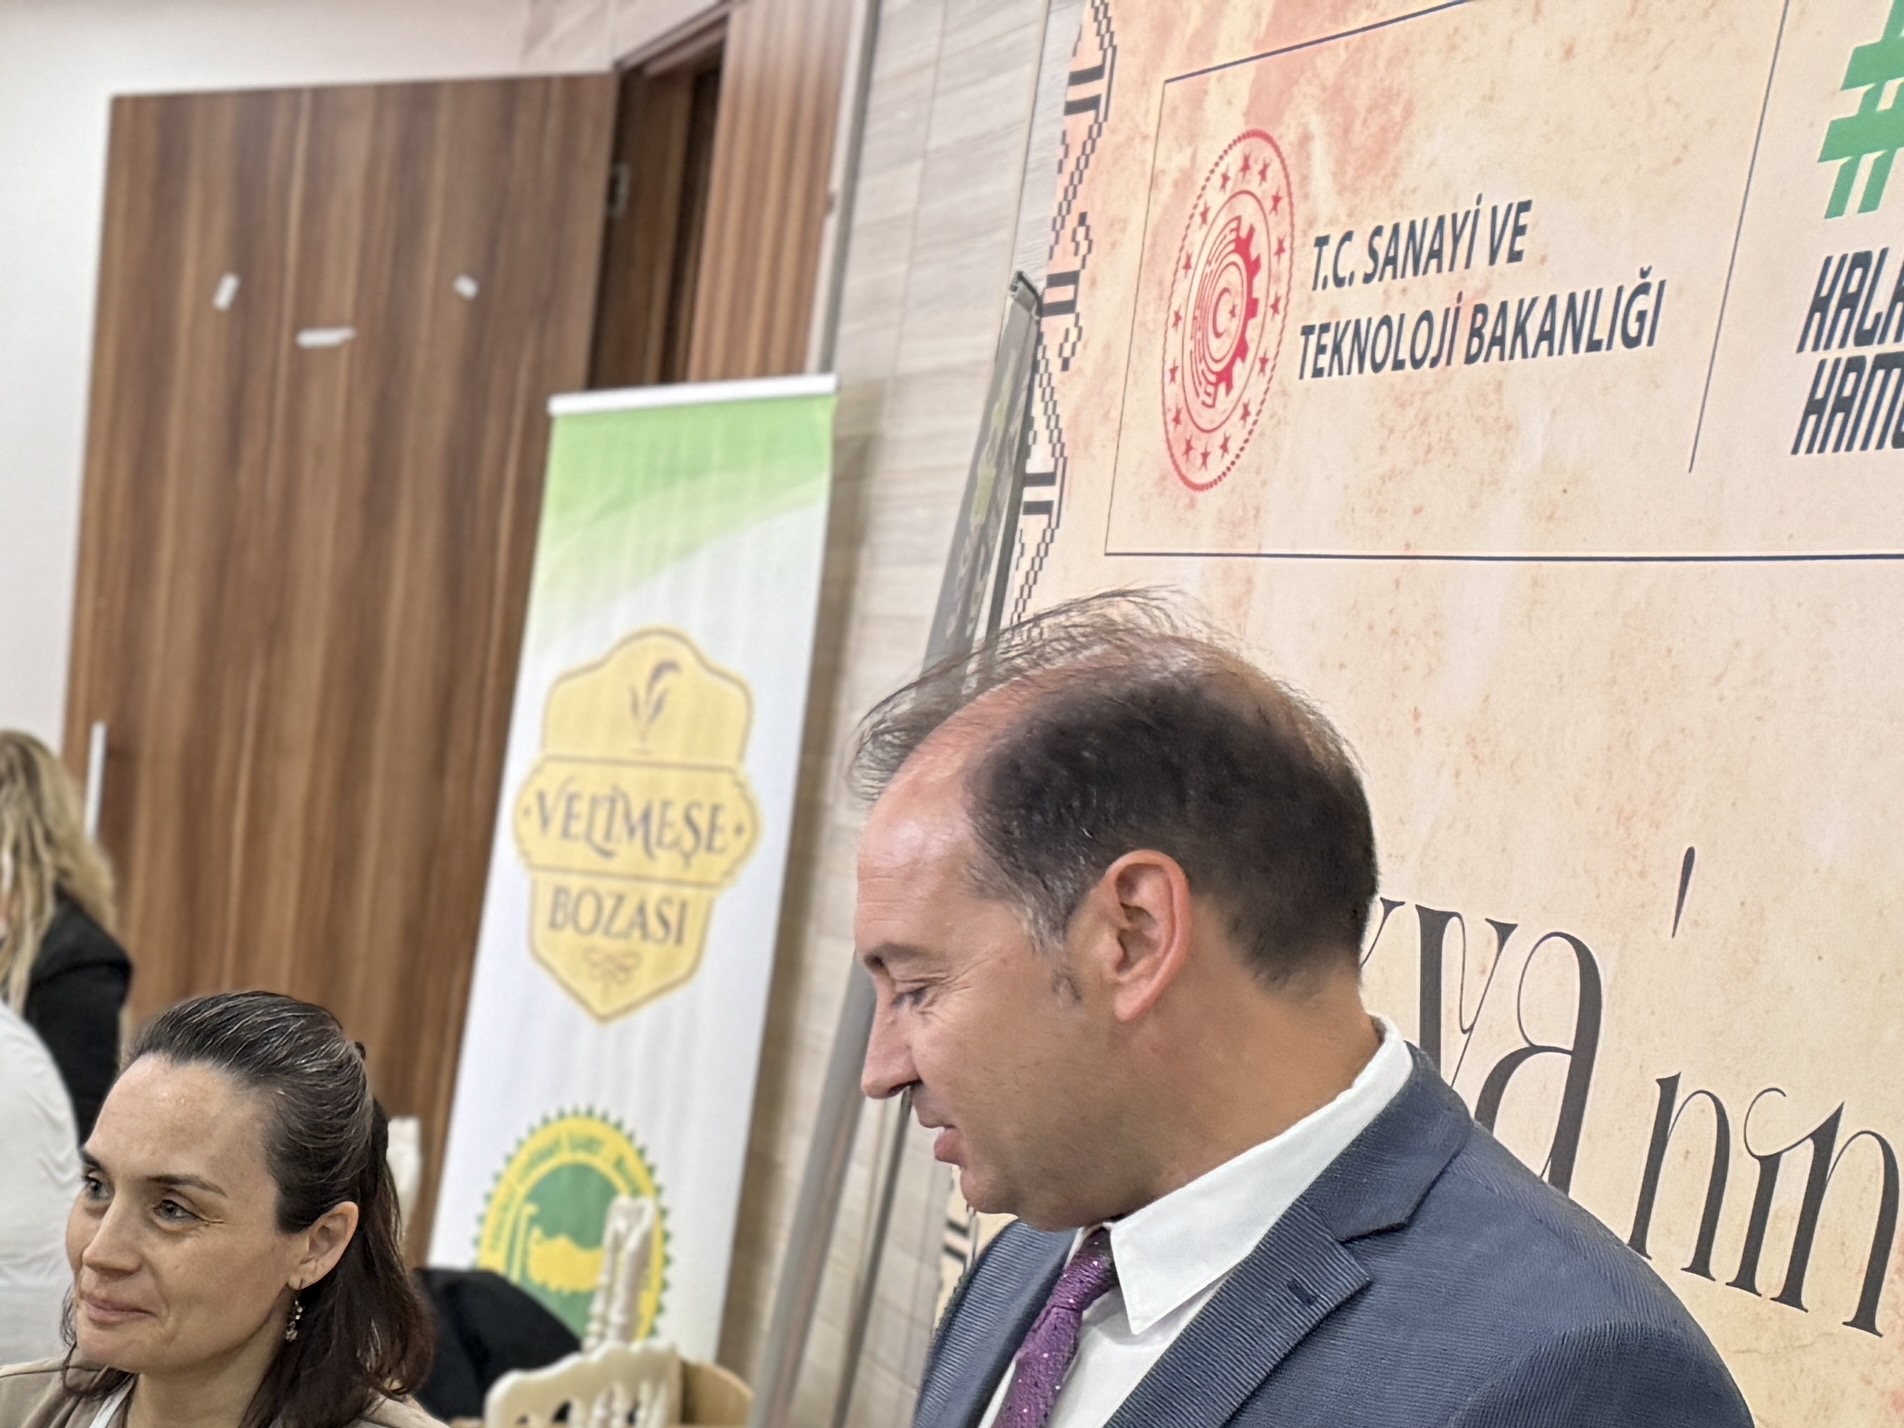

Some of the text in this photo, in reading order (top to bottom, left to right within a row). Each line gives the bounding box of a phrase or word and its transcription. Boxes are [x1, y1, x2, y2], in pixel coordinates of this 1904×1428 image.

[1312, 193, 1533, 292] T.C. SANAYİ VE
[1298, 265, 1667, 380] TEKNOLOJİ BAKANLIĞI
[548, 885, 688, 947] BOZASI
